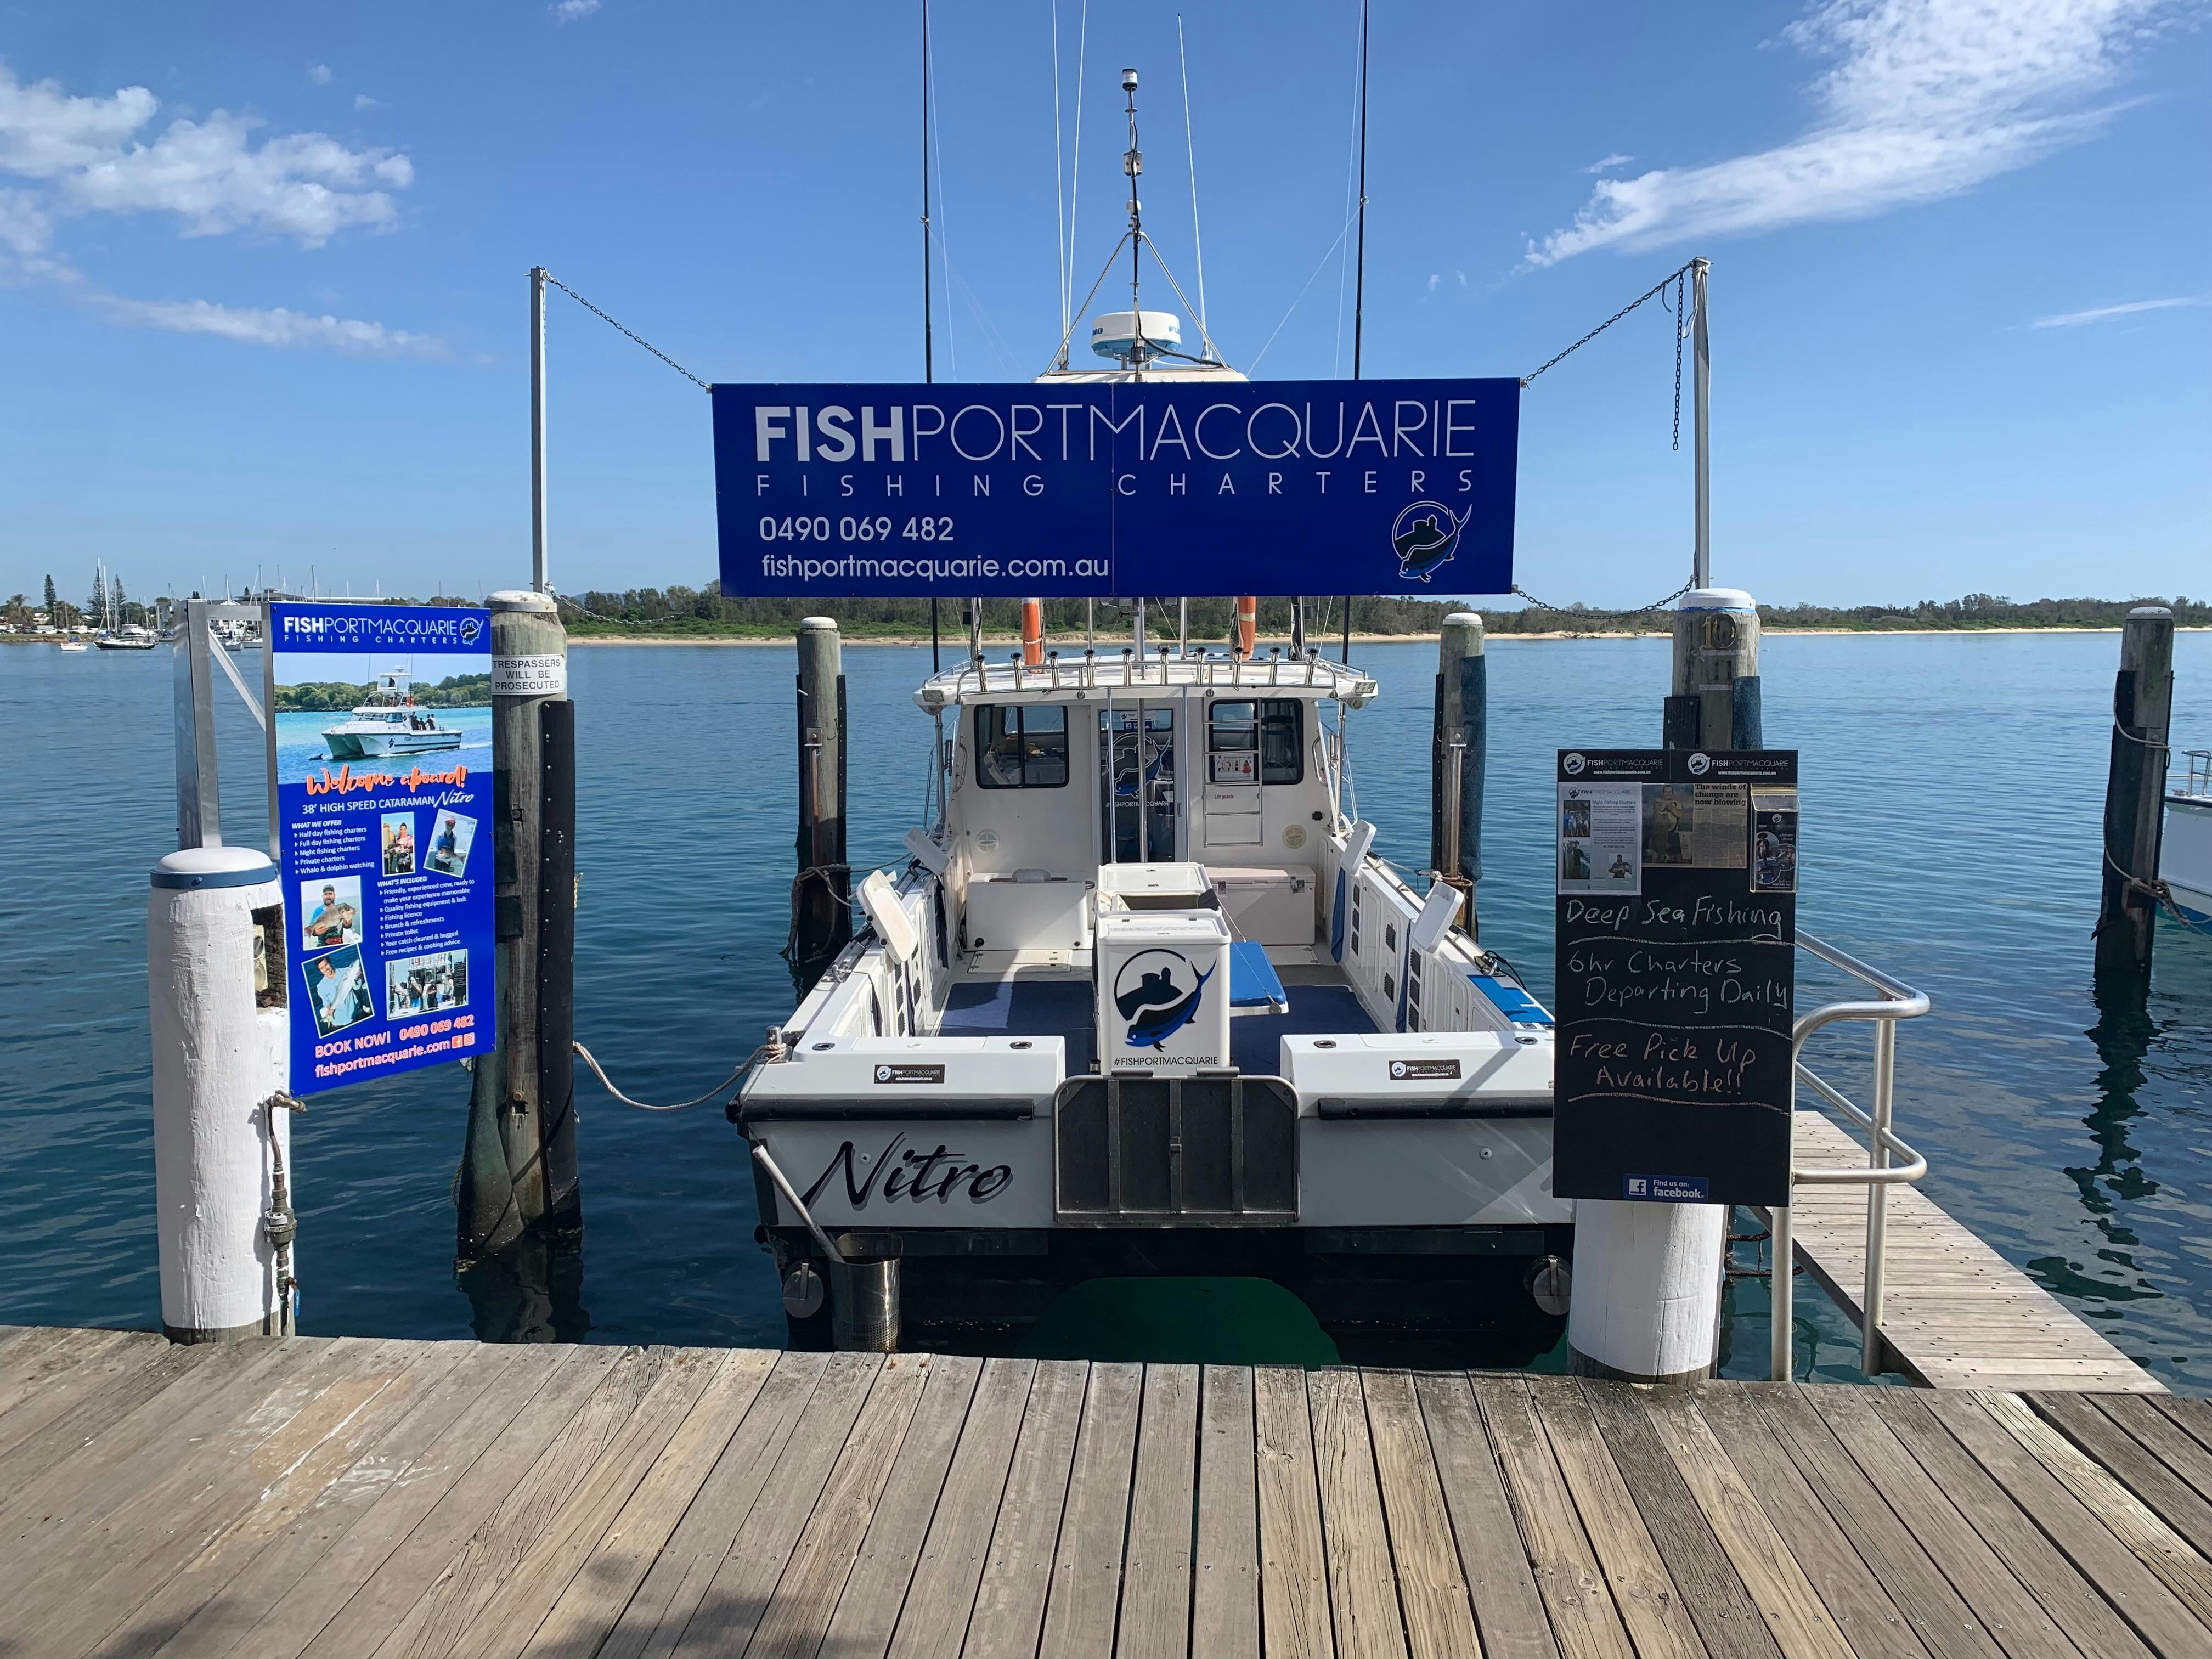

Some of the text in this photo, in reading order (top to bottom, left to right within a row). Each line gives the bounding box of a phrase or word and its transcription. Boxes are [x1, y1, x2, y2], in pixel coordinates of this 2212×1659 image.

[755, 400, 1476, 461] FISHPORTMACQUARIE
[758, 470, 1471, 496] FISHING CHARTERS
[759, 517, 954, 541] 0490 069 482
[762, 555, 1109, 581] fishportmacquarie.com.au
[284, 616, 457, 636] FISHPORTMACQUARIE
[284, 635, 458, 644] FISHING CHARTERS
[493, 659, 560, 668] TRESPASSERS
[495, 680, 559, 690] PROSECUTED
[307, 764, 467, 795] Welcome aboard!
[302, 789, 475, 814] 38' HIGH SPEED CATARAMAN Nitro
[377, 876, 427, 887] WHAT'S INCLUDED
[408, 883, 439, 893] experienced
[413, 892, 441, 901] experience
[441, 888, 470, 896] memorable
[423, 898, 450, 907] equipment
[385, 921, 404, 929] Brunch
[410, 916, 445, 926] refreshments
[1567, 895, 1782, 940] Deep Sea Fishing
[398, 946, 417, 954] recipes
[424, 940, 443, 949] cooking
[413, 934, 433, 942] cleaned
[1567, 949, 1742, 974] 6hr Charters
[1584, 976, 1788, 1014] Departing Daily
[315, 1014, 475, 1058] BOOK NOW! 0490 069 482
[315, 1040, 450, 1078] fishportmacquarie.com
[1114, 1056, 1218, 1066] #FISHPORTMACQUARIE
[1570, 1032, 1756, 1073] Free Pick Up
[1596, 1066, 1743, 1095] Available!!
[800, 1131, 1013, 1211] Nitro
